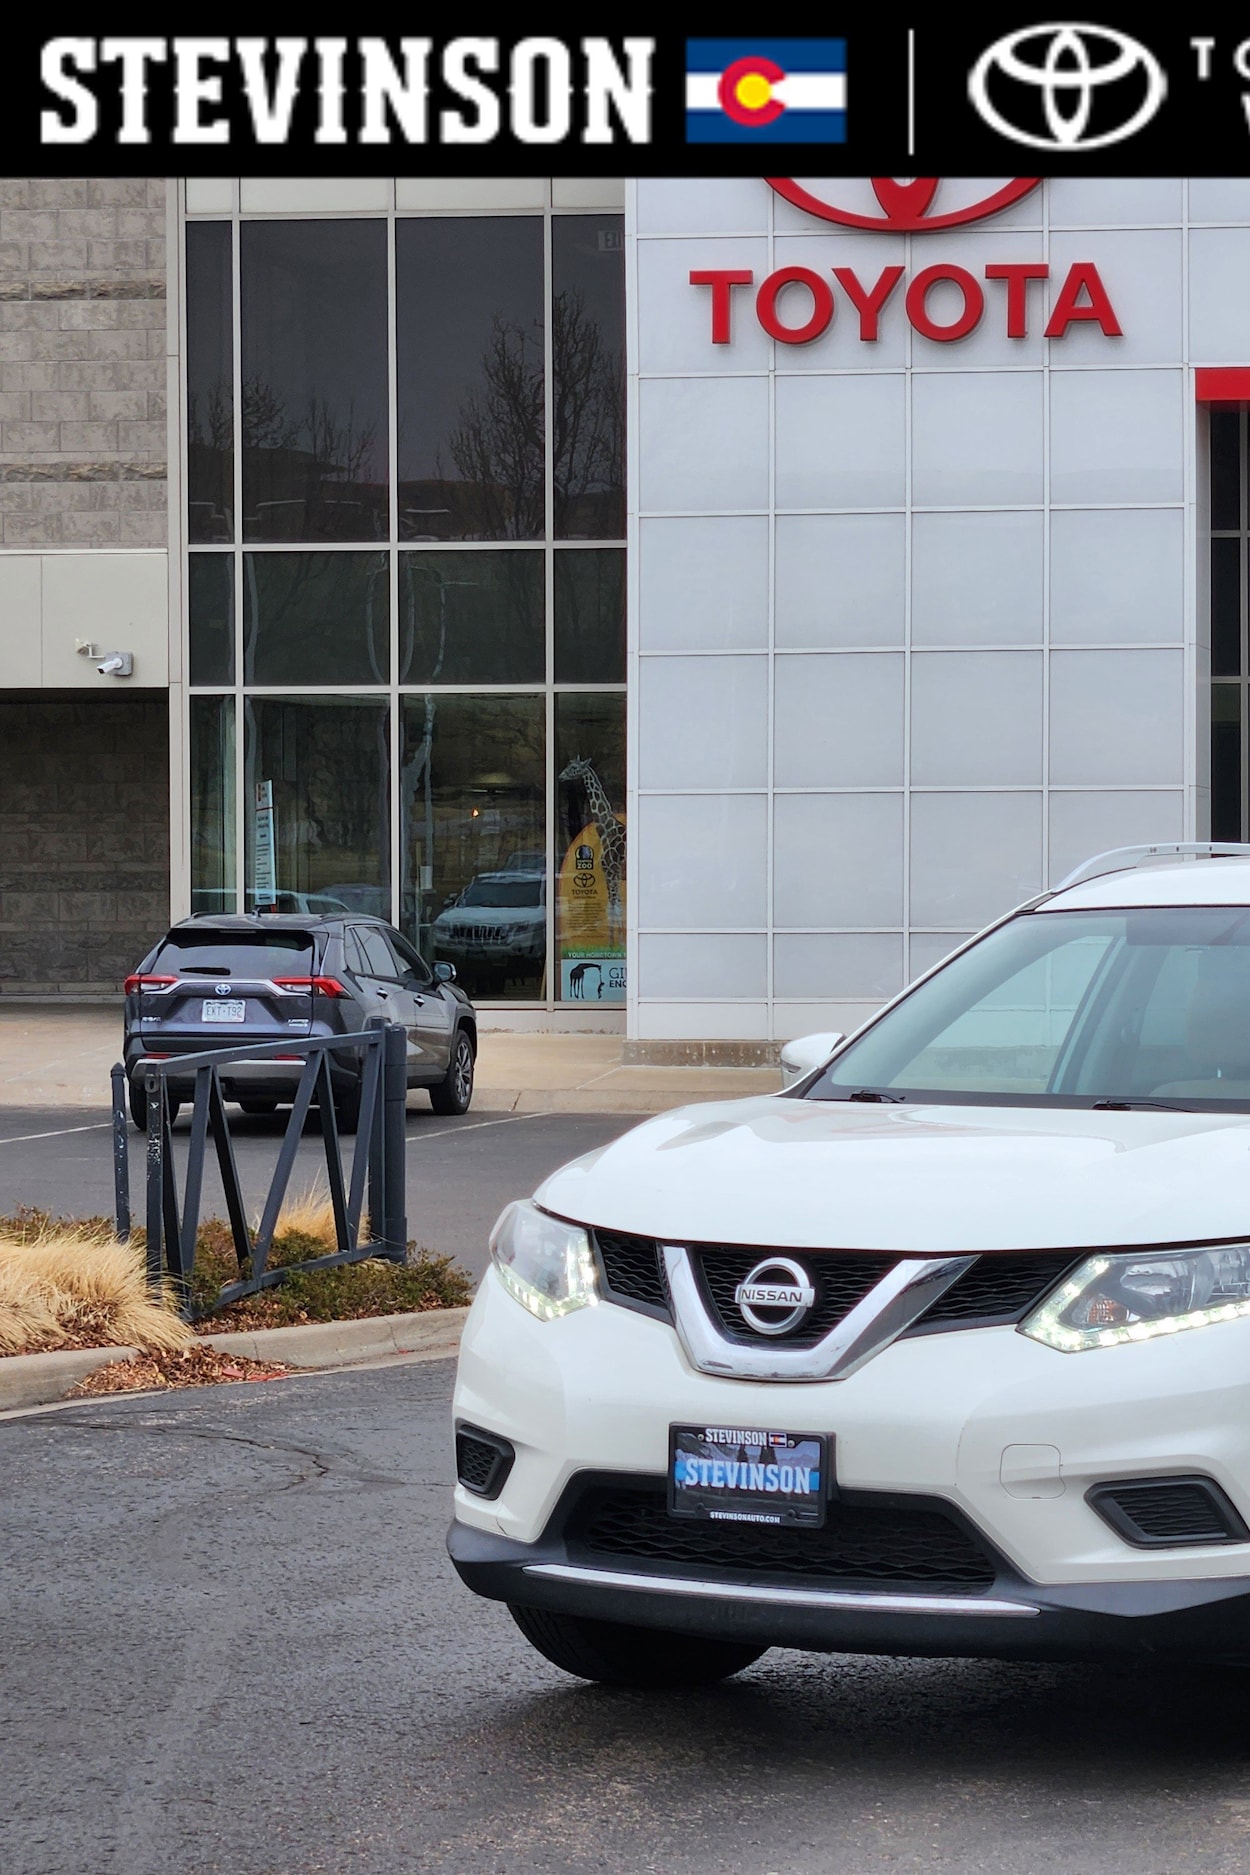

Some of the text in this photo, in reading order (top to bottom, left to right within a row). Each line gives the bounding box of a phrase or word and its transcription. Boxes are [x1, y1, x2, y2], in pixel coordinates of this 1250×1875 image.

[691, 264, 1121, 343] TOYOTA
[741, 1289, 802, 1303] NISSAN
[705, 1428, 768, 1446] STEVINSON
[685, 1458, 812, 1495] STEVINSON
[710, 1511, 781, 1524] STEVINSONAUTO.COM
